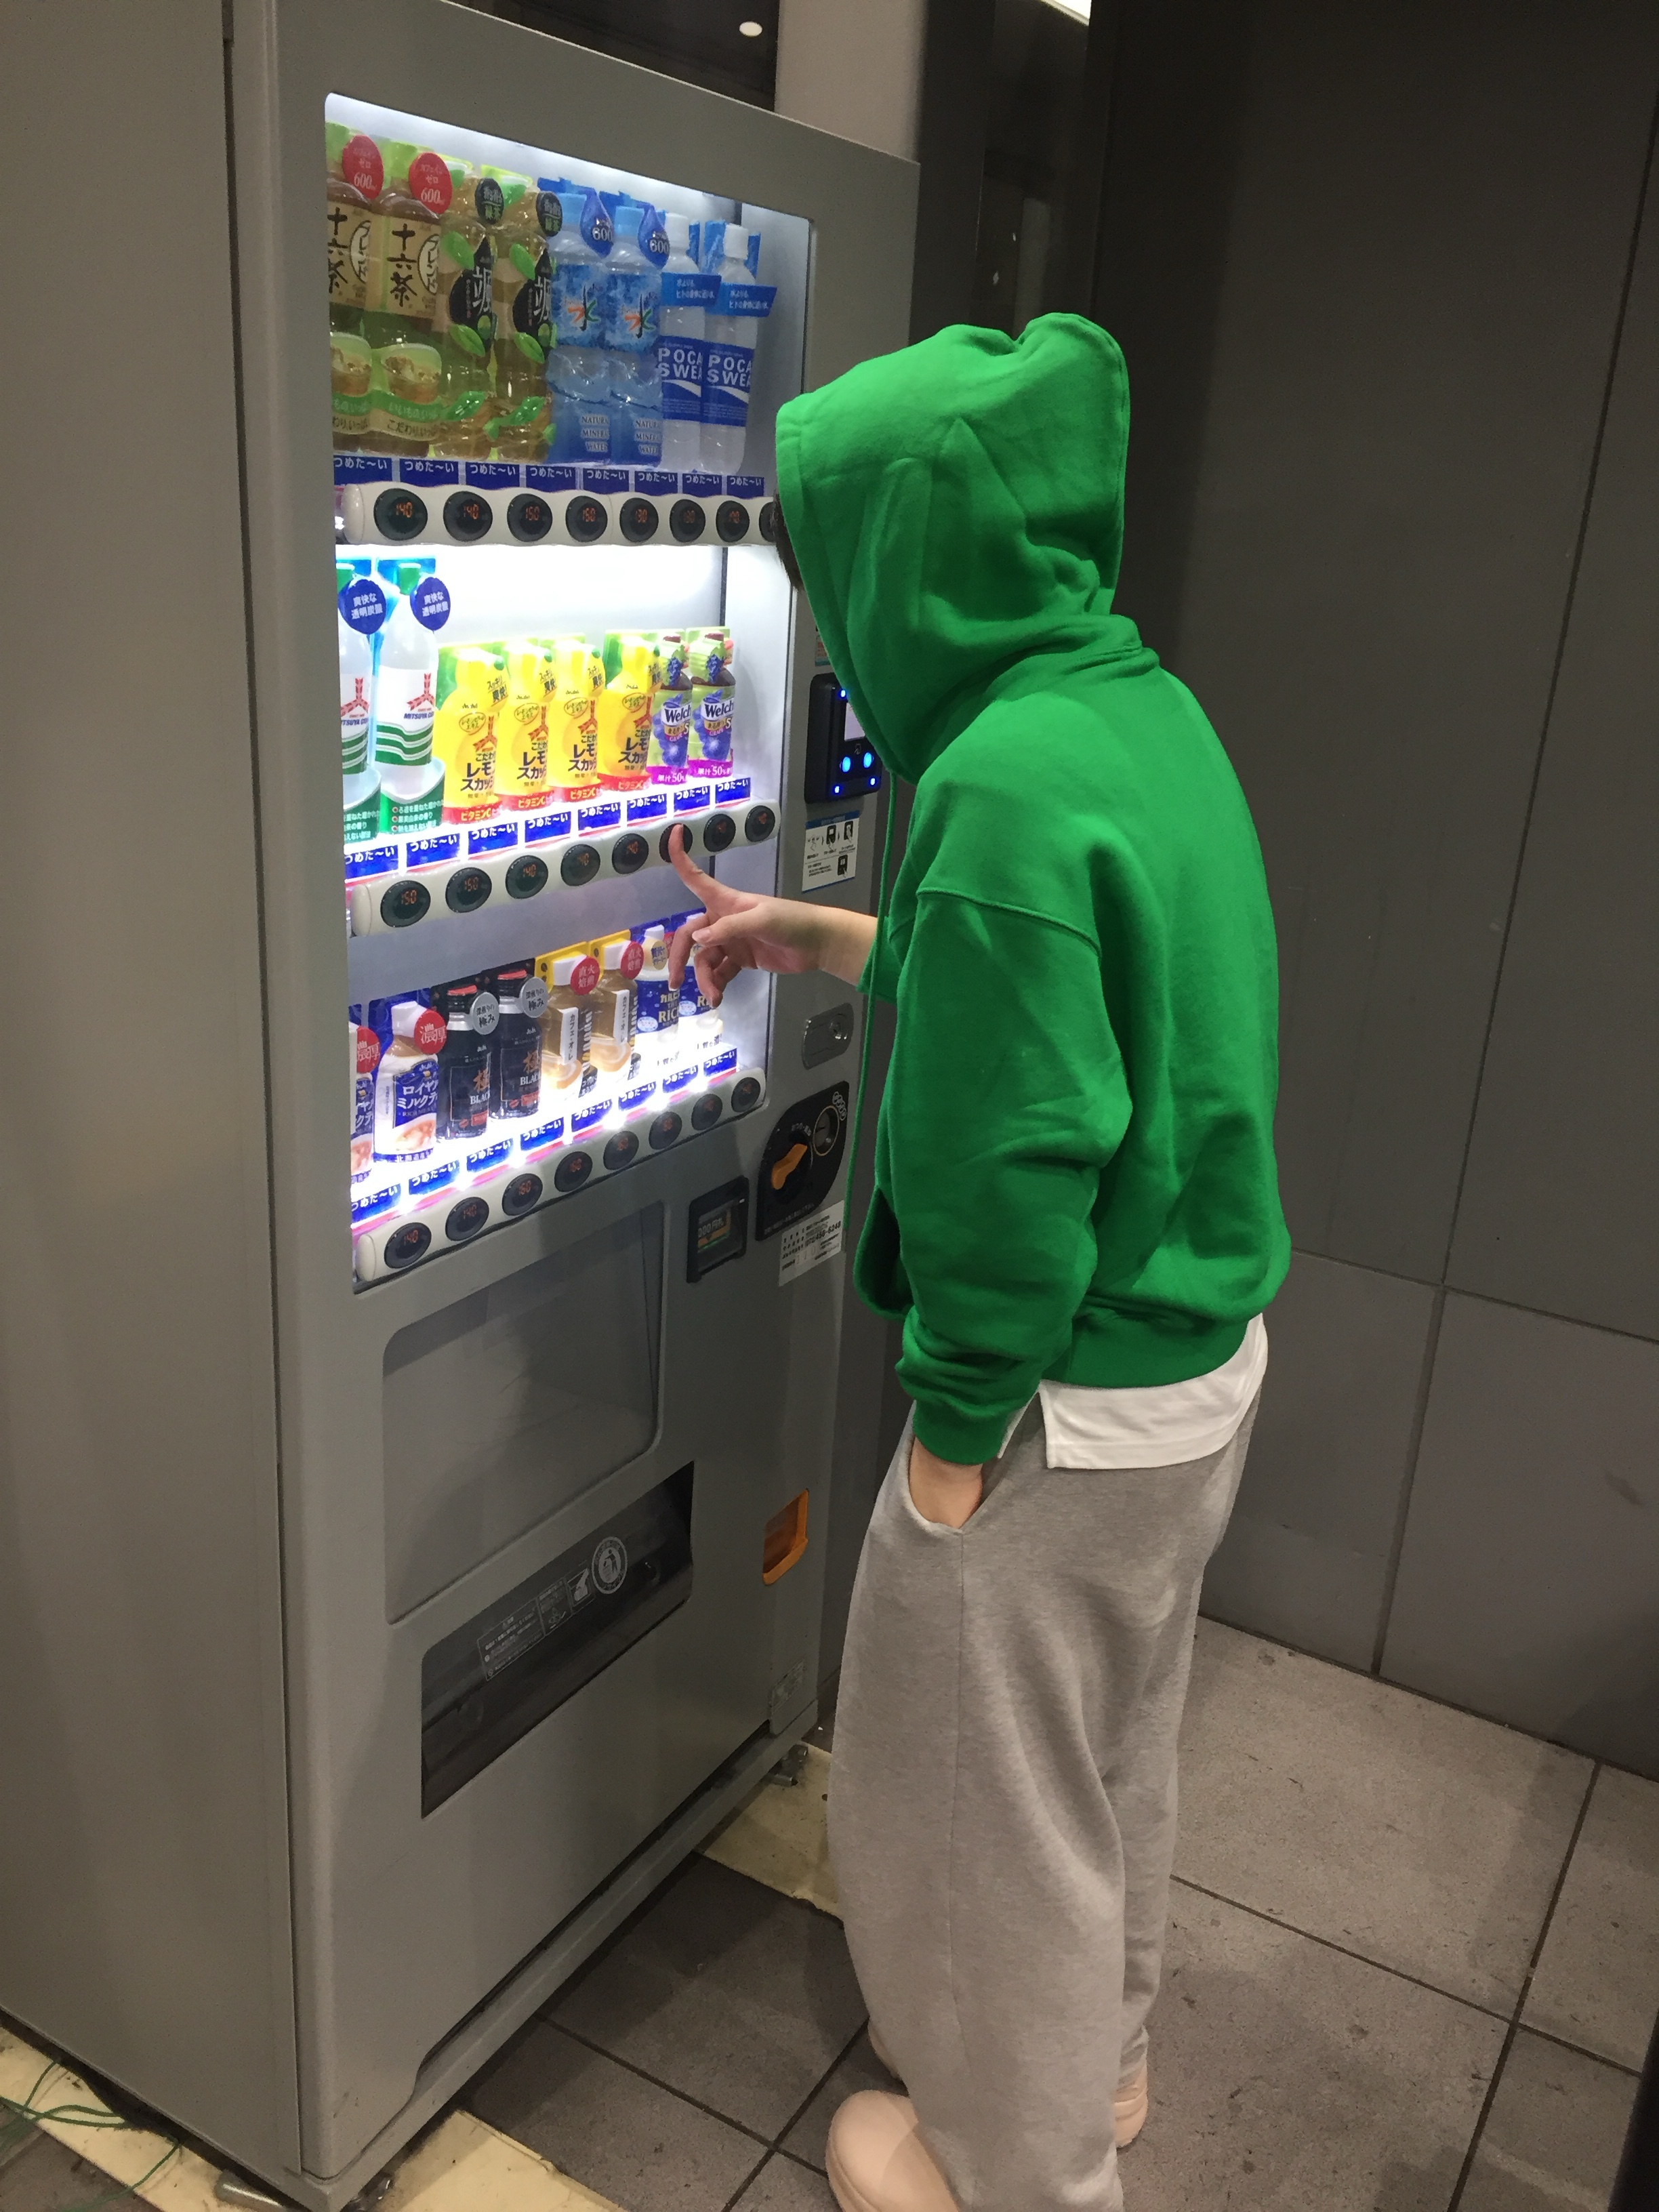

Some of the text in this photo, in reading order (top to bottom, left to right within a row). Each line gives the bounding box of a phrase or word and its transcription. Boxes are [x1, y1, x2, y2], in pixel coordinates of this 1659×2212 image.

[386, 223, 417, 307] 十六茶
[420, 1023, 447, 1044] 濃厚
